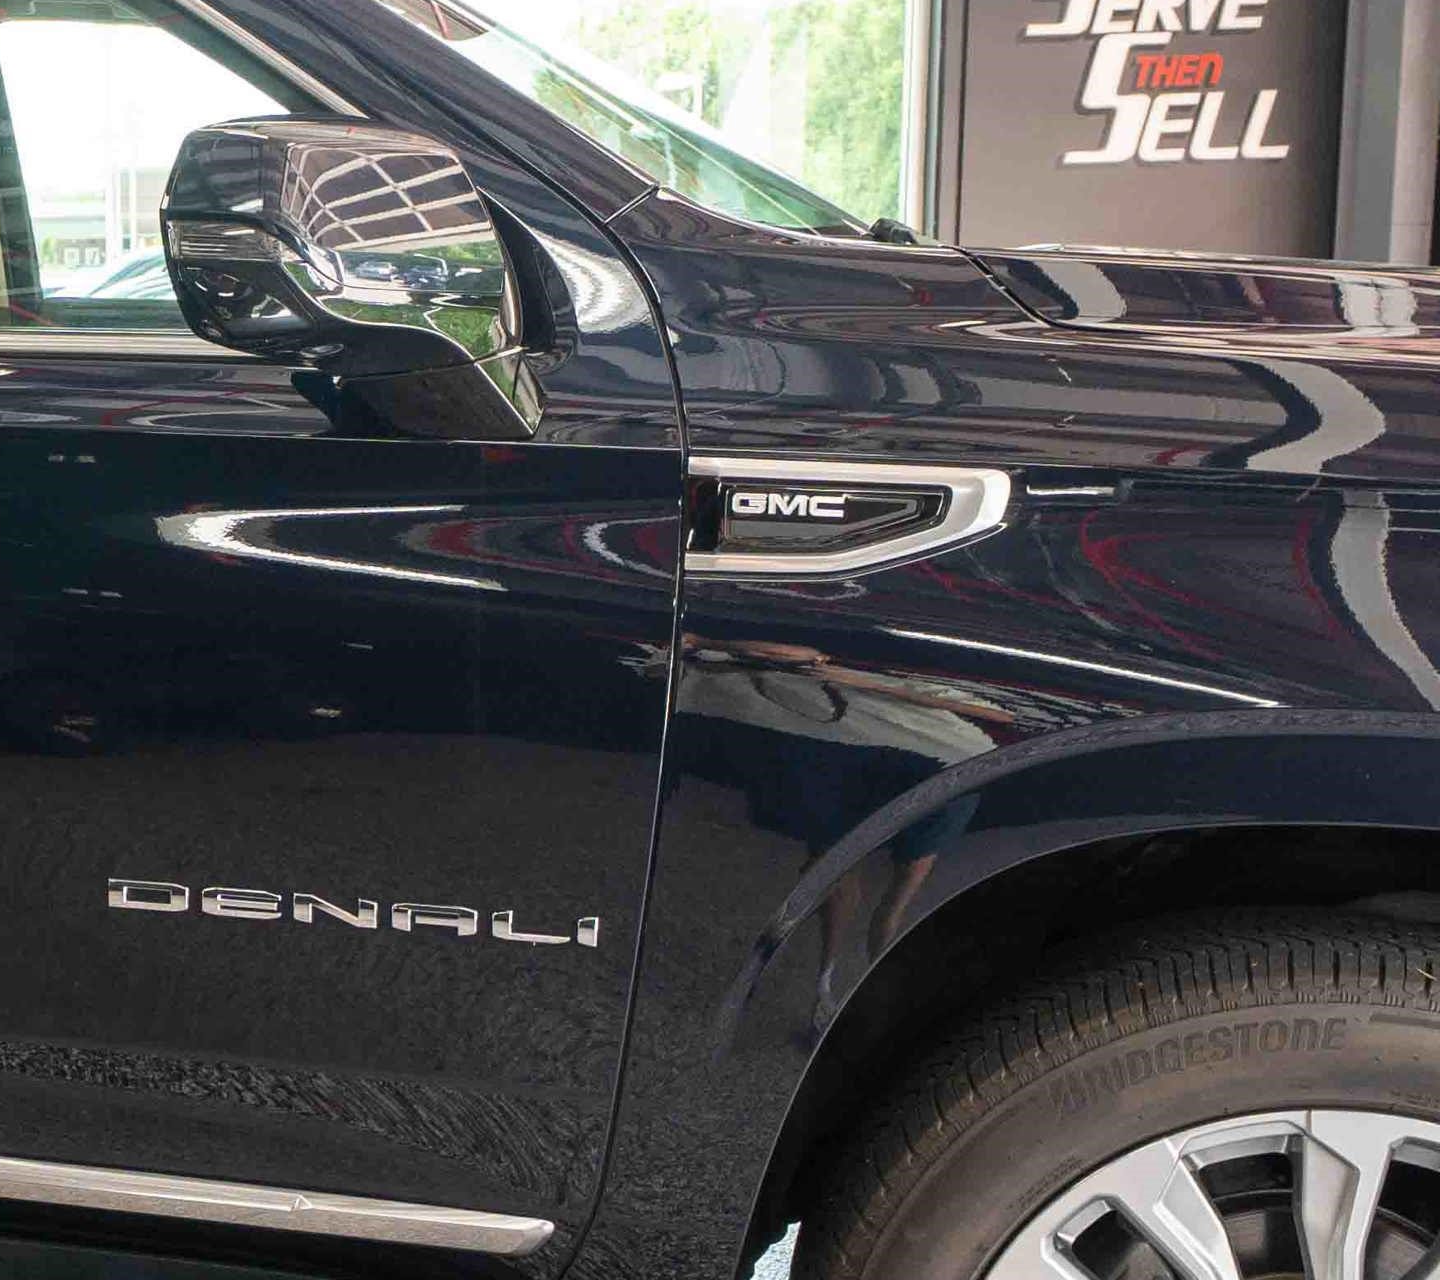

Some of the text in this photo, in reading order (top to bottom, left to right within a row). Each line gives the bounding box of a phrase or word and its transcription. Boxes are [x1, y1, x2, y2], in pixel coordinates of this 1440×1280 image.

[1135, 53, 1224, 89] THEN
[1062, 32, 1290, 165] SELL
[731, 492, 849, 519] GMC
[107, 877, 599, 948] DENALI
